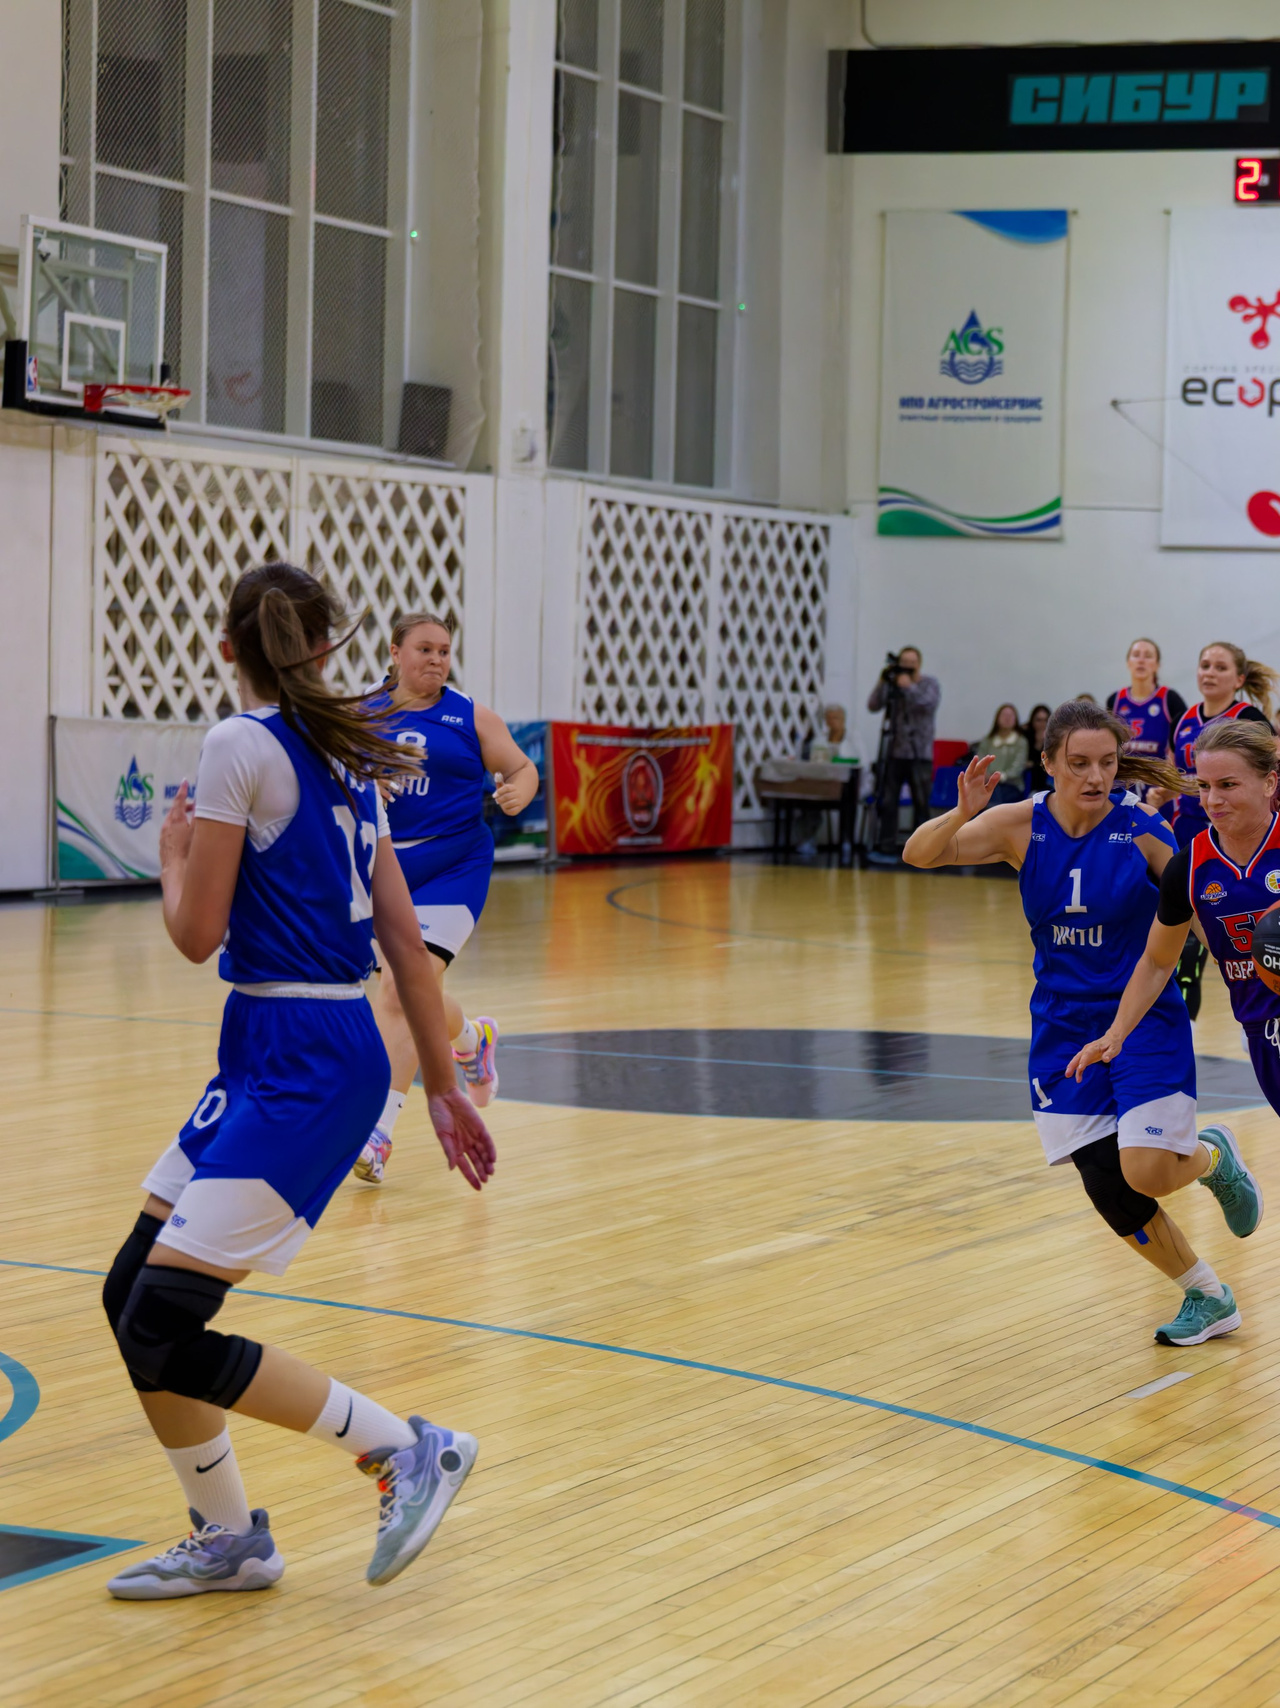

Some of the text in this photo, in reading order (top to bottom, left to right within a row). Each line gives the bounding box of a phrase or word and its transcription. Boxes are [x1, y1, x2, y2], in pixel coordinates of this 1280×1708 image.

[1009, 71, 1268, 125] СИБУР
[1064, 867, 1088, 914] 1
[1032, 1077, 1053, 1110] 1
